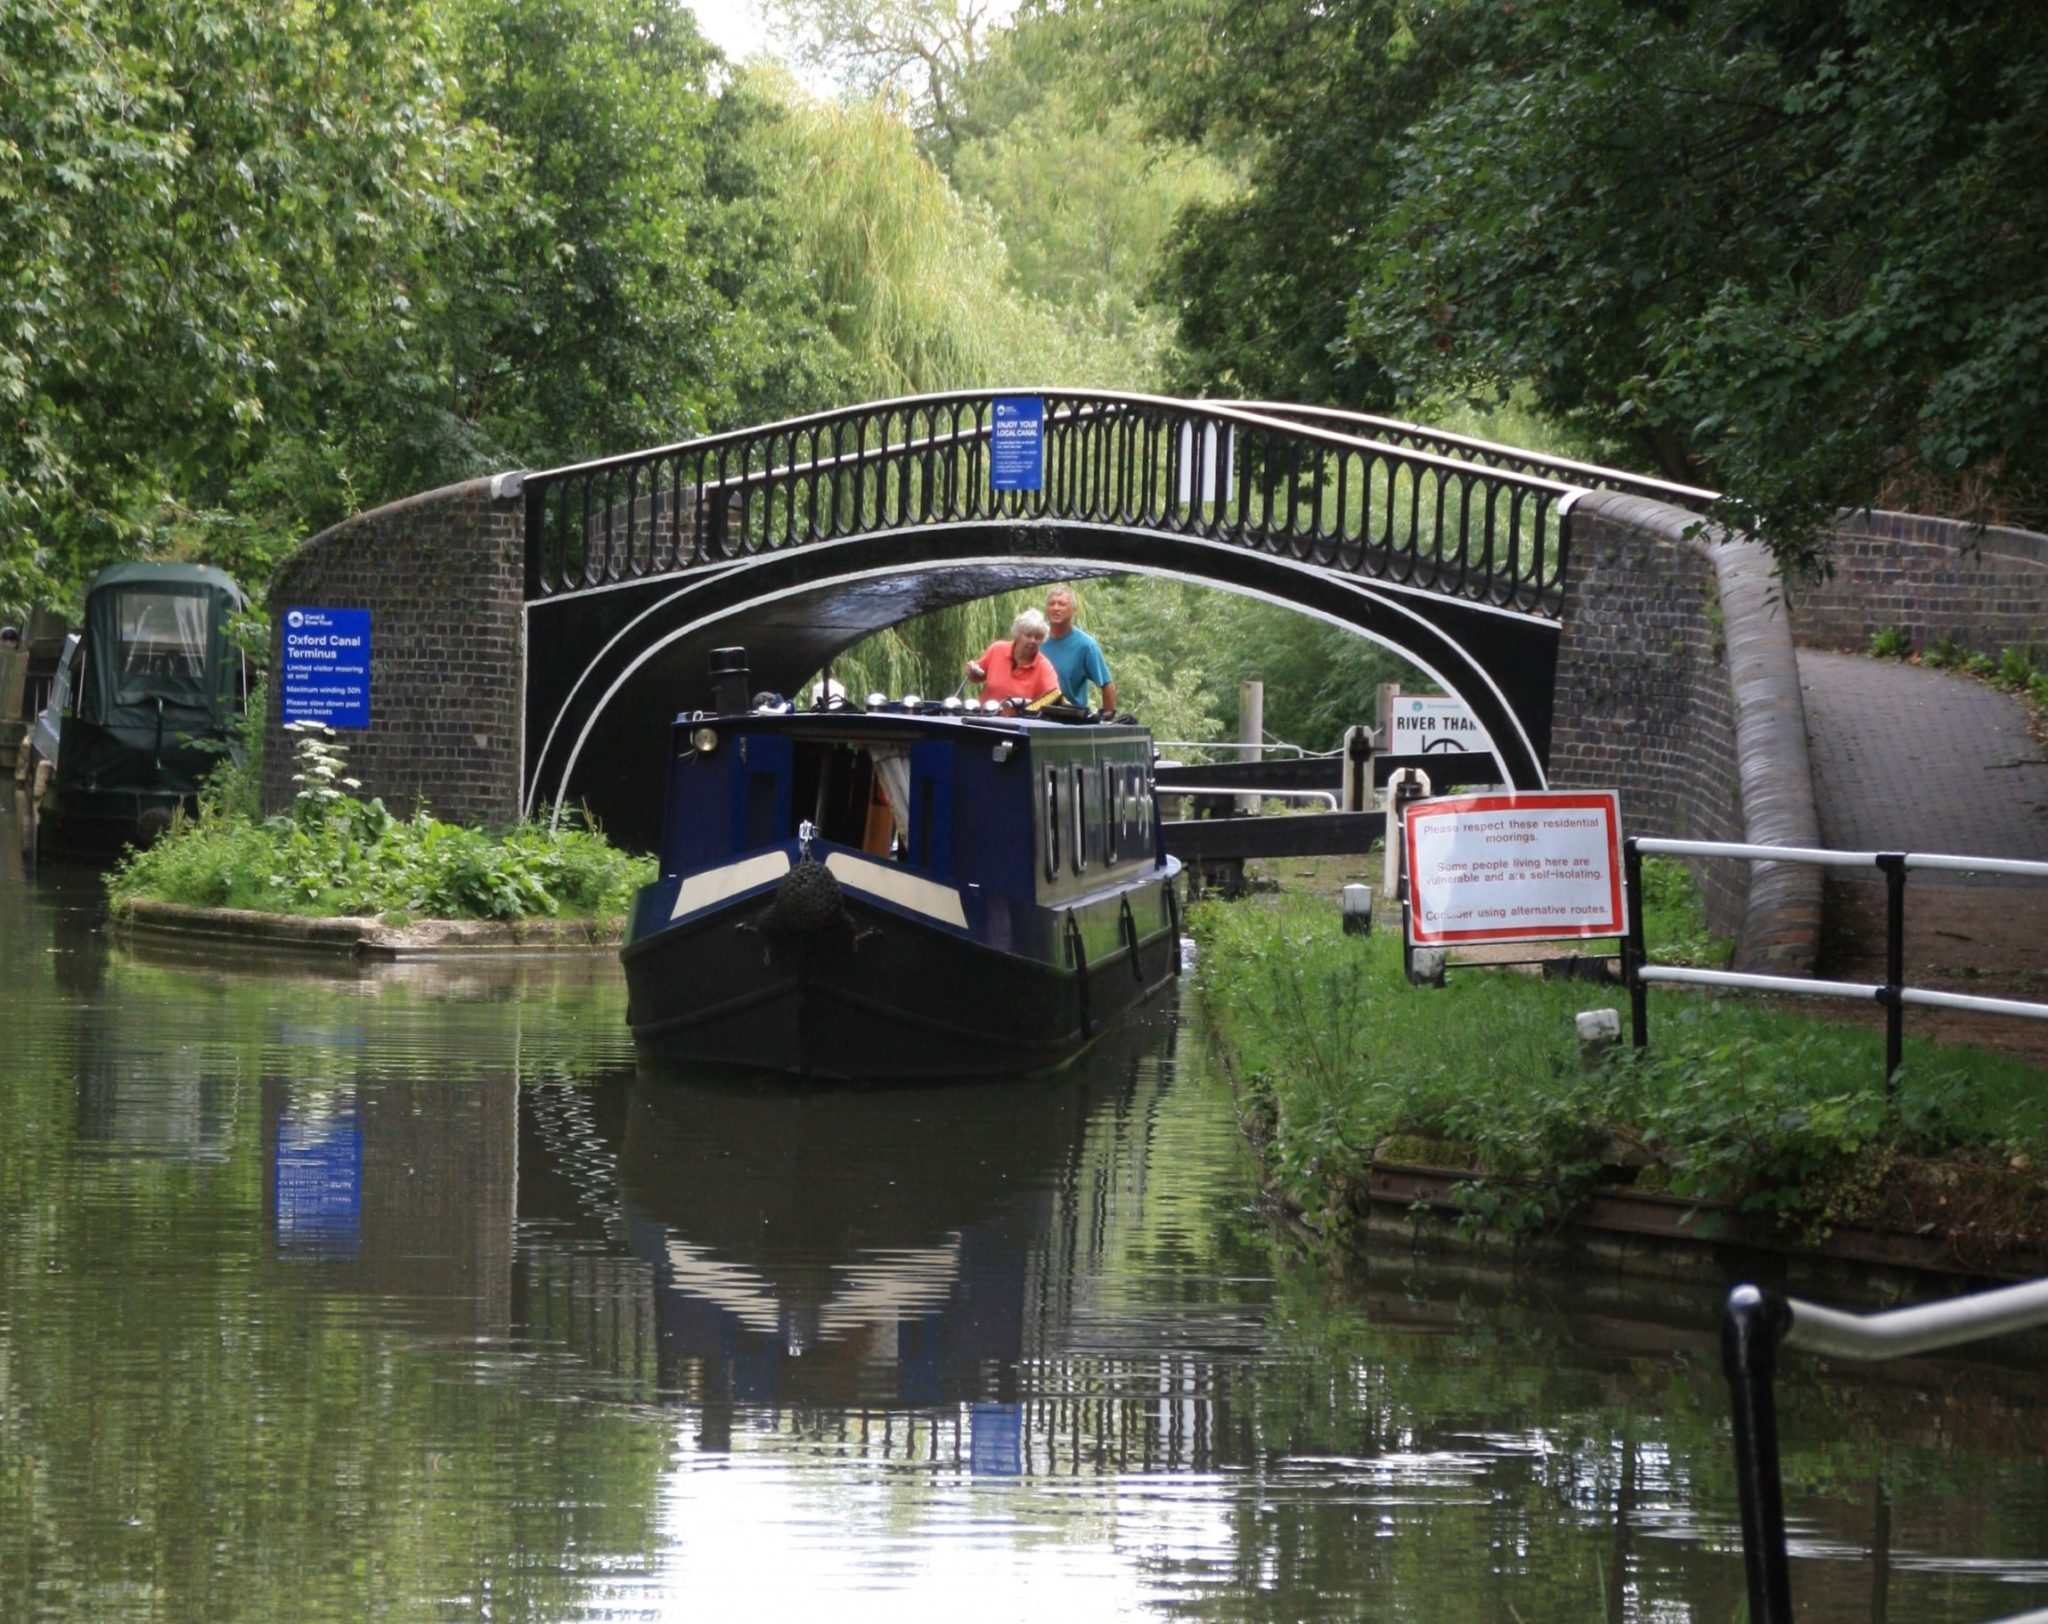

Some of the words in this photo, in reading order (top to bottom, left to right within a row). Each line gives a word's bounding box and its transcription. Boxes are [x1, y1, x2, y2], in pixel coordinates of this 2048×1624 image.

[288, 634, 326, 645] Oxford
[330, 635, 360, 646] Canal
[288, 647, 337, 659] Terminus
[335, 666, 364, 674] mooring
[320, 686, 346, 695] winding
[1396, 716, 1436, 730] RIVER
[1424, 825, 1459, 834] Please
[1464, 821, 1504, 832] respect
[1509, 819, 1538, 829] these
[1543, 818, 1599, 828] residential
[1486, 832, 1539, 843] moorings.
[1438, 862, 1468, 872] Some
[1472, 860, 1509, 871] people
[1513, 858, 1541, 869] living
[1545, 858, 1568, 866] here
[1573, 858, 1590, 866] are
[1484, 873, 1504, 882] and
[1530, 870, 1603, 880] self-isolating.
[1478, 907, 1506, 918] using
[1511, 906, 1566, 916] alternative
[1570, 905, 1608, 914] routes.
